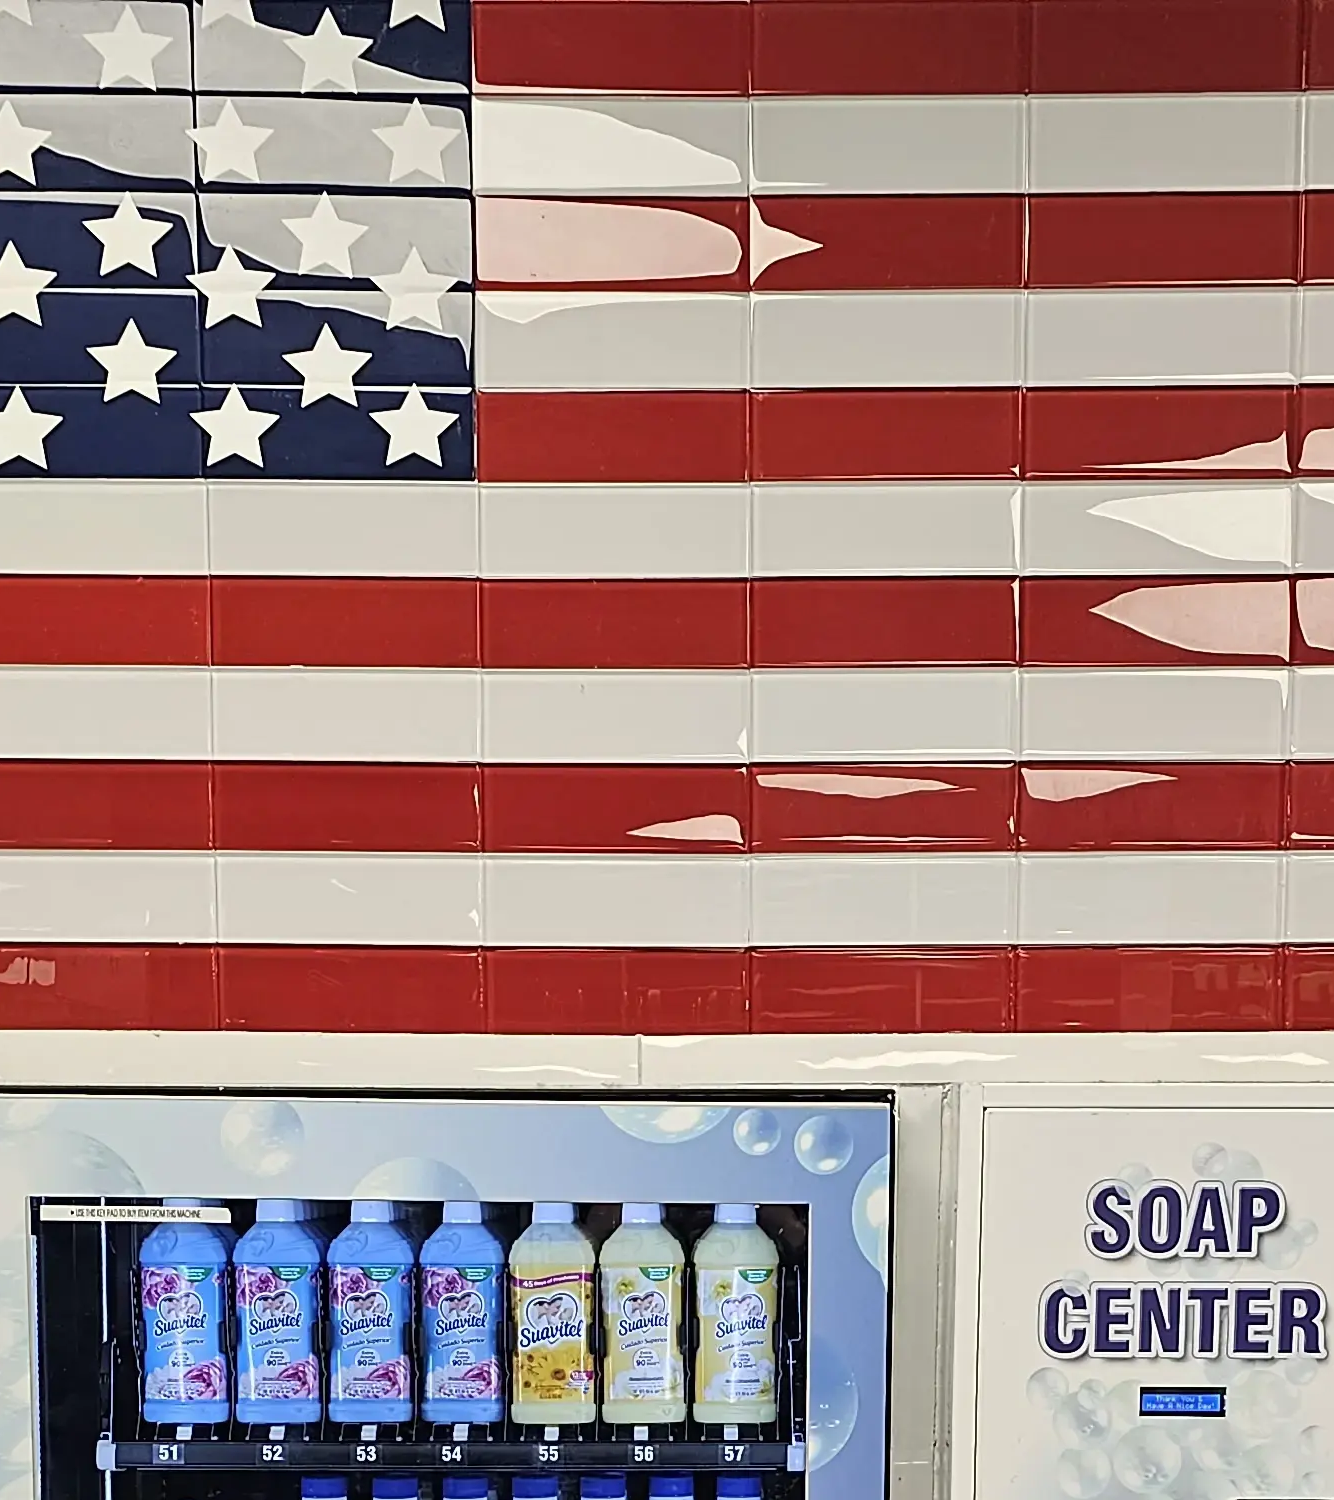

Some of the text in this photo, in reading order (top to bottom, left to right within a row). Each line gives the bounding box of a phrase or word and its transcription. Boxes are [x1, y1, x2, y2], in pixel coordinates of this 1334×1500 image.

[1087, 1182, 1284, 1256] SOAP
[155, 1314, 206, 1337] Suavitel
[249, 1313, 302, 1335] Suavitel
[340, 1314, 394, 1337] Suavitel
[435, 1312, 489, 1337] Suavitel
[618, 1312, 670, 1337] Suavitel
[1041, 1282, 1326, 1358] CENTER
[519, 1320, 584, 1348] Suavitel
[158, 1444, 179, 1461] 51
[262, 1444, 284, 1461] 52
[356, 1445, 377, 1462] 53
[441, 1445, 462, 1462] 54
[538, 1444, 559, 1462] 55
[634, 1445, 654, 1462] 56
[724, 1445, 745, 1462] 57
